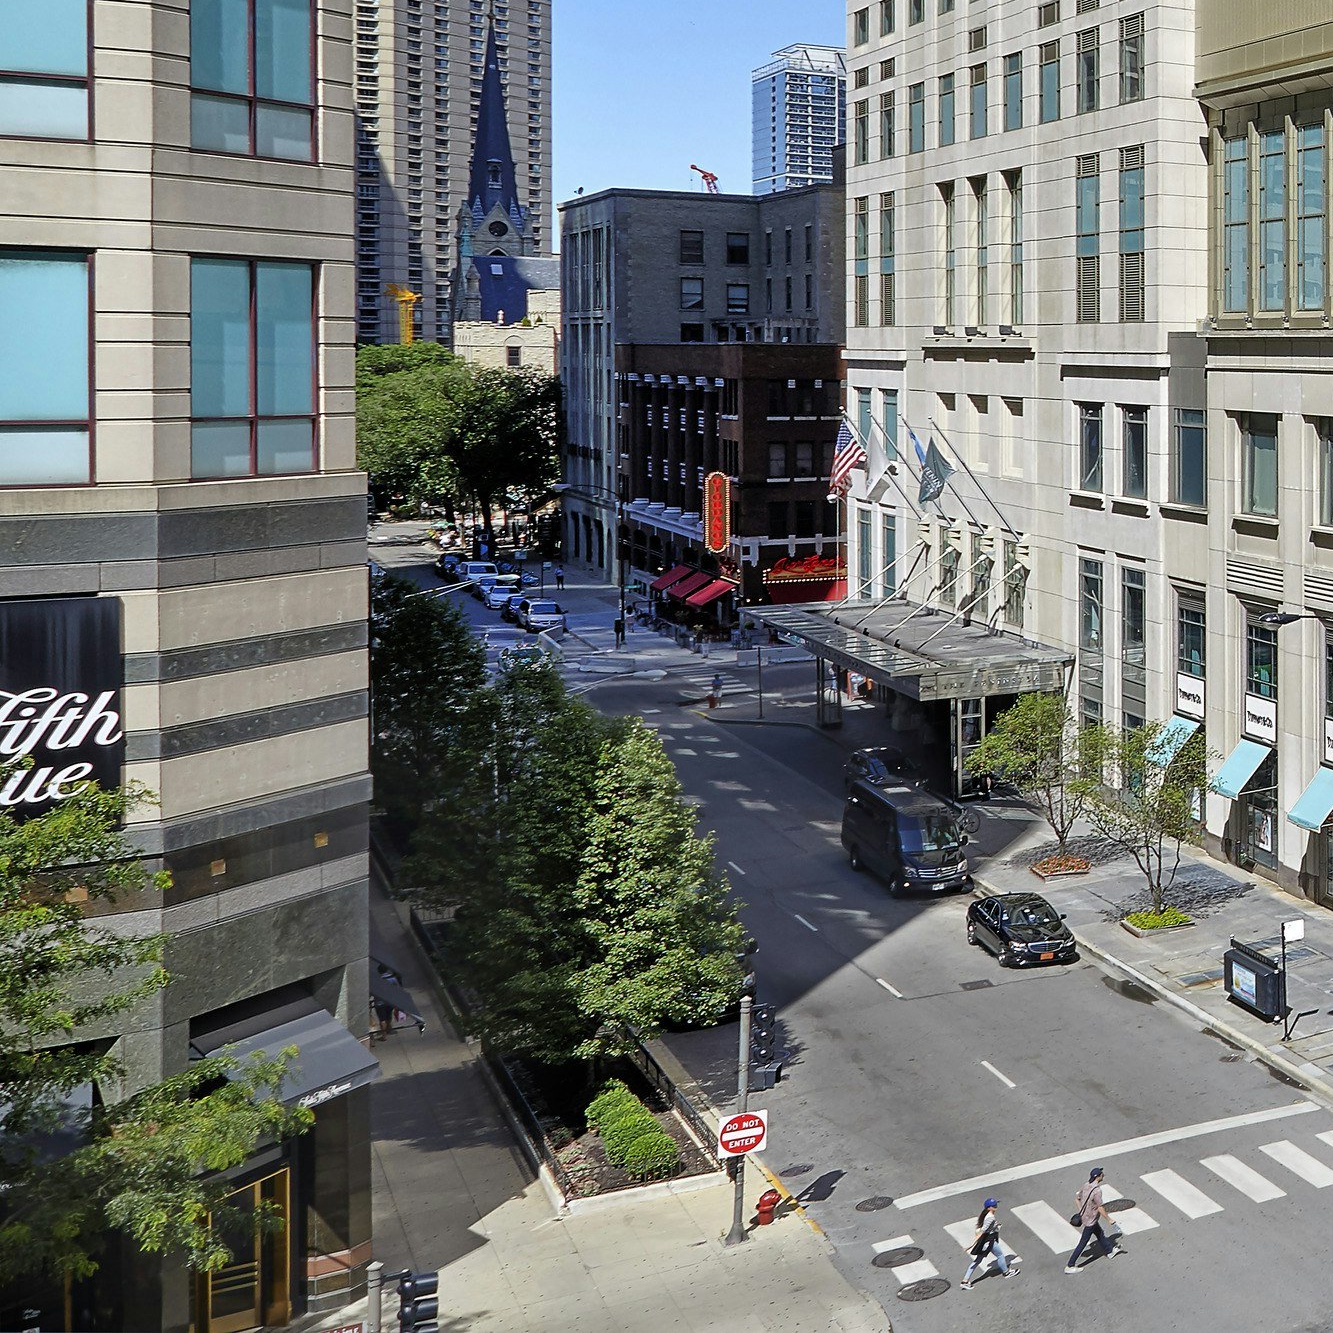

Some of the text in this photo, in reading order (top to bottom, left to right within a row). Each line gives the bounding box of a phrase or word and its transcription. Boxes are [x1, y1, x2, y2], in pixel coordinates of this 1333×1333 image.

[726, 1119, 760, 1131] DO NOT
[728, 1137, 756, 1149] ENTER
